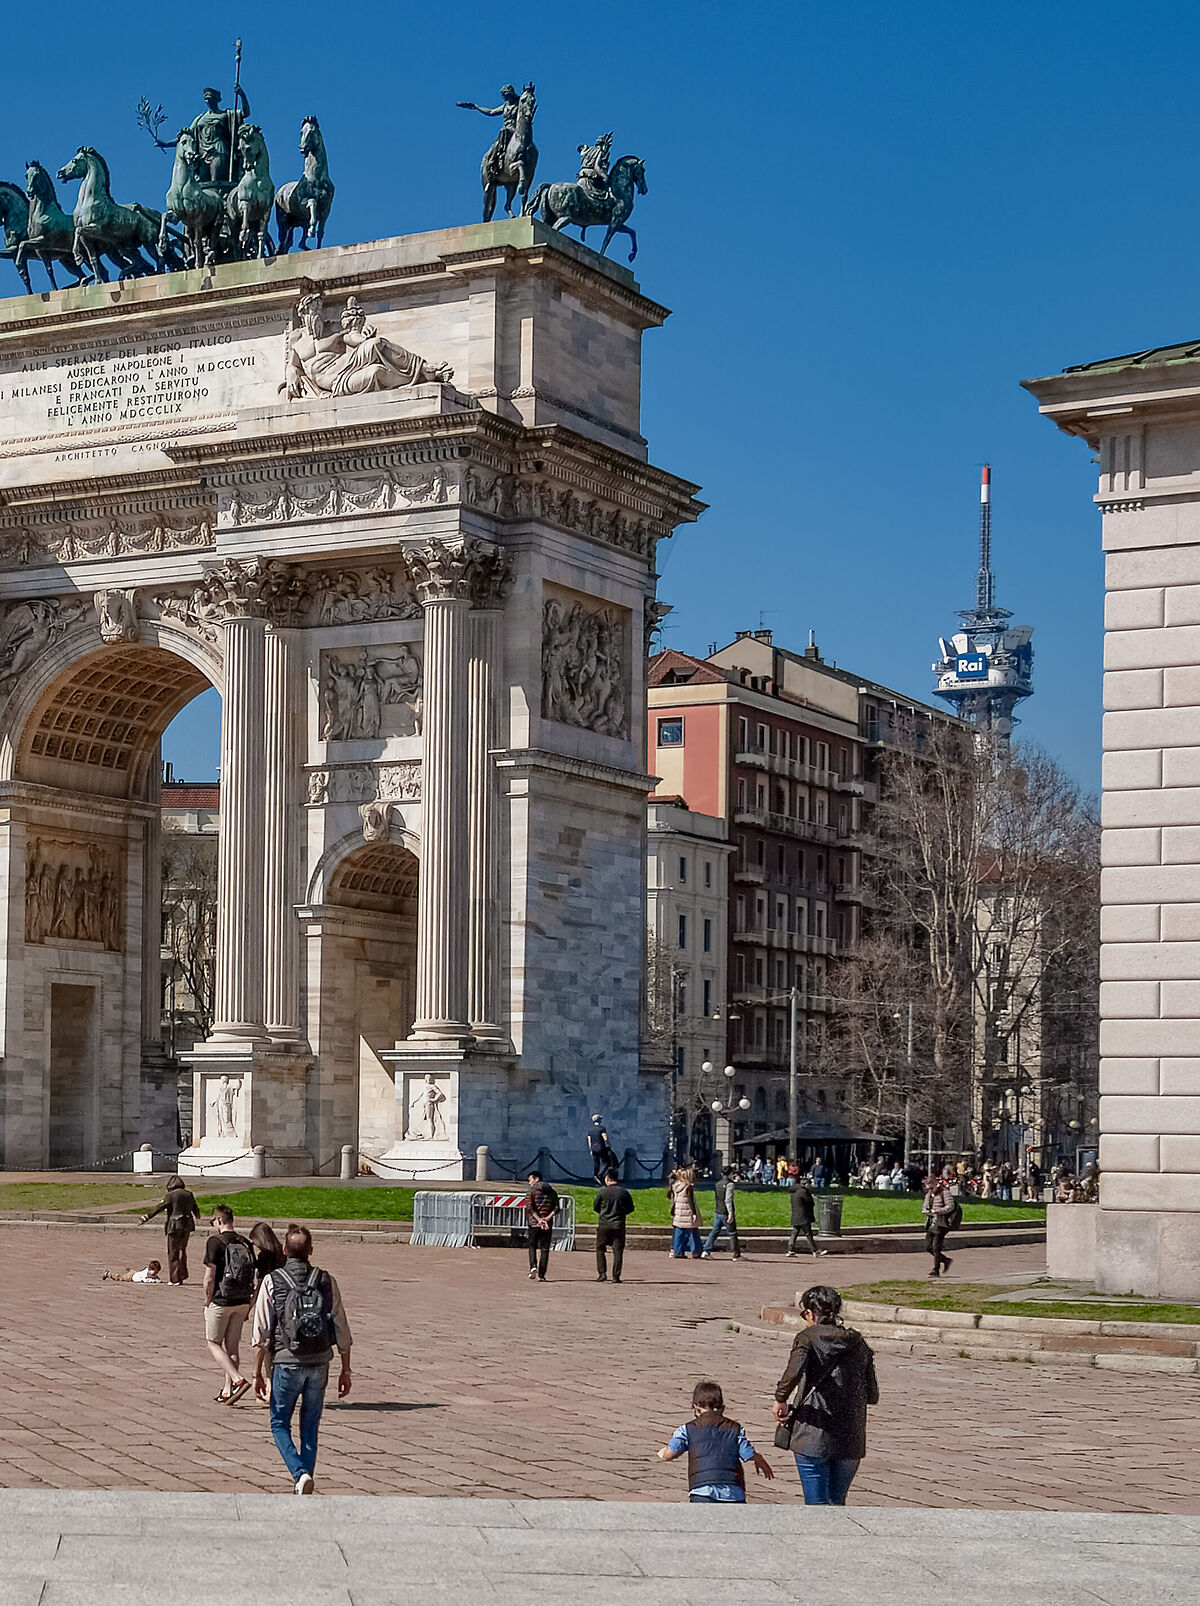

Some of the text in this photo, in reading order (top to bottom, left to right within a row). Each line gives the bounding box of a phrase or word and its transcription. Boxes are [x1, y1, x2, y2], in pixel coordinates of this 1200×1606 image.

[22, 334, 232, 373] ALLE SPERANZE DEL REGNO ITALICO
[0, 391, 4, 400] I
[11, 383, 62, 399] MILANESI
[70, 373, 140, 391] DEDICARONO
[158, 366, 188, 379] ANNO
[196, 356, 255, 373] MDCCCVII
[67, 354, 184, 379] AUSPICE NAPOLEONE I
[47, 387, 209, 417] FELICEMENTE RESTITUIRONO
[56, 395, 61, 405] E
[69, 387, 122, 403] FRANCATI
[132, 385, 146, 395] DA
[81, 412, 113, 425] ANNO
[119, 403, 182, 420] MDCCCLIX
[54, 440, 180, 462] ARCHITETTO CAGNOLA
[958, 657, 983, 672] Rai
